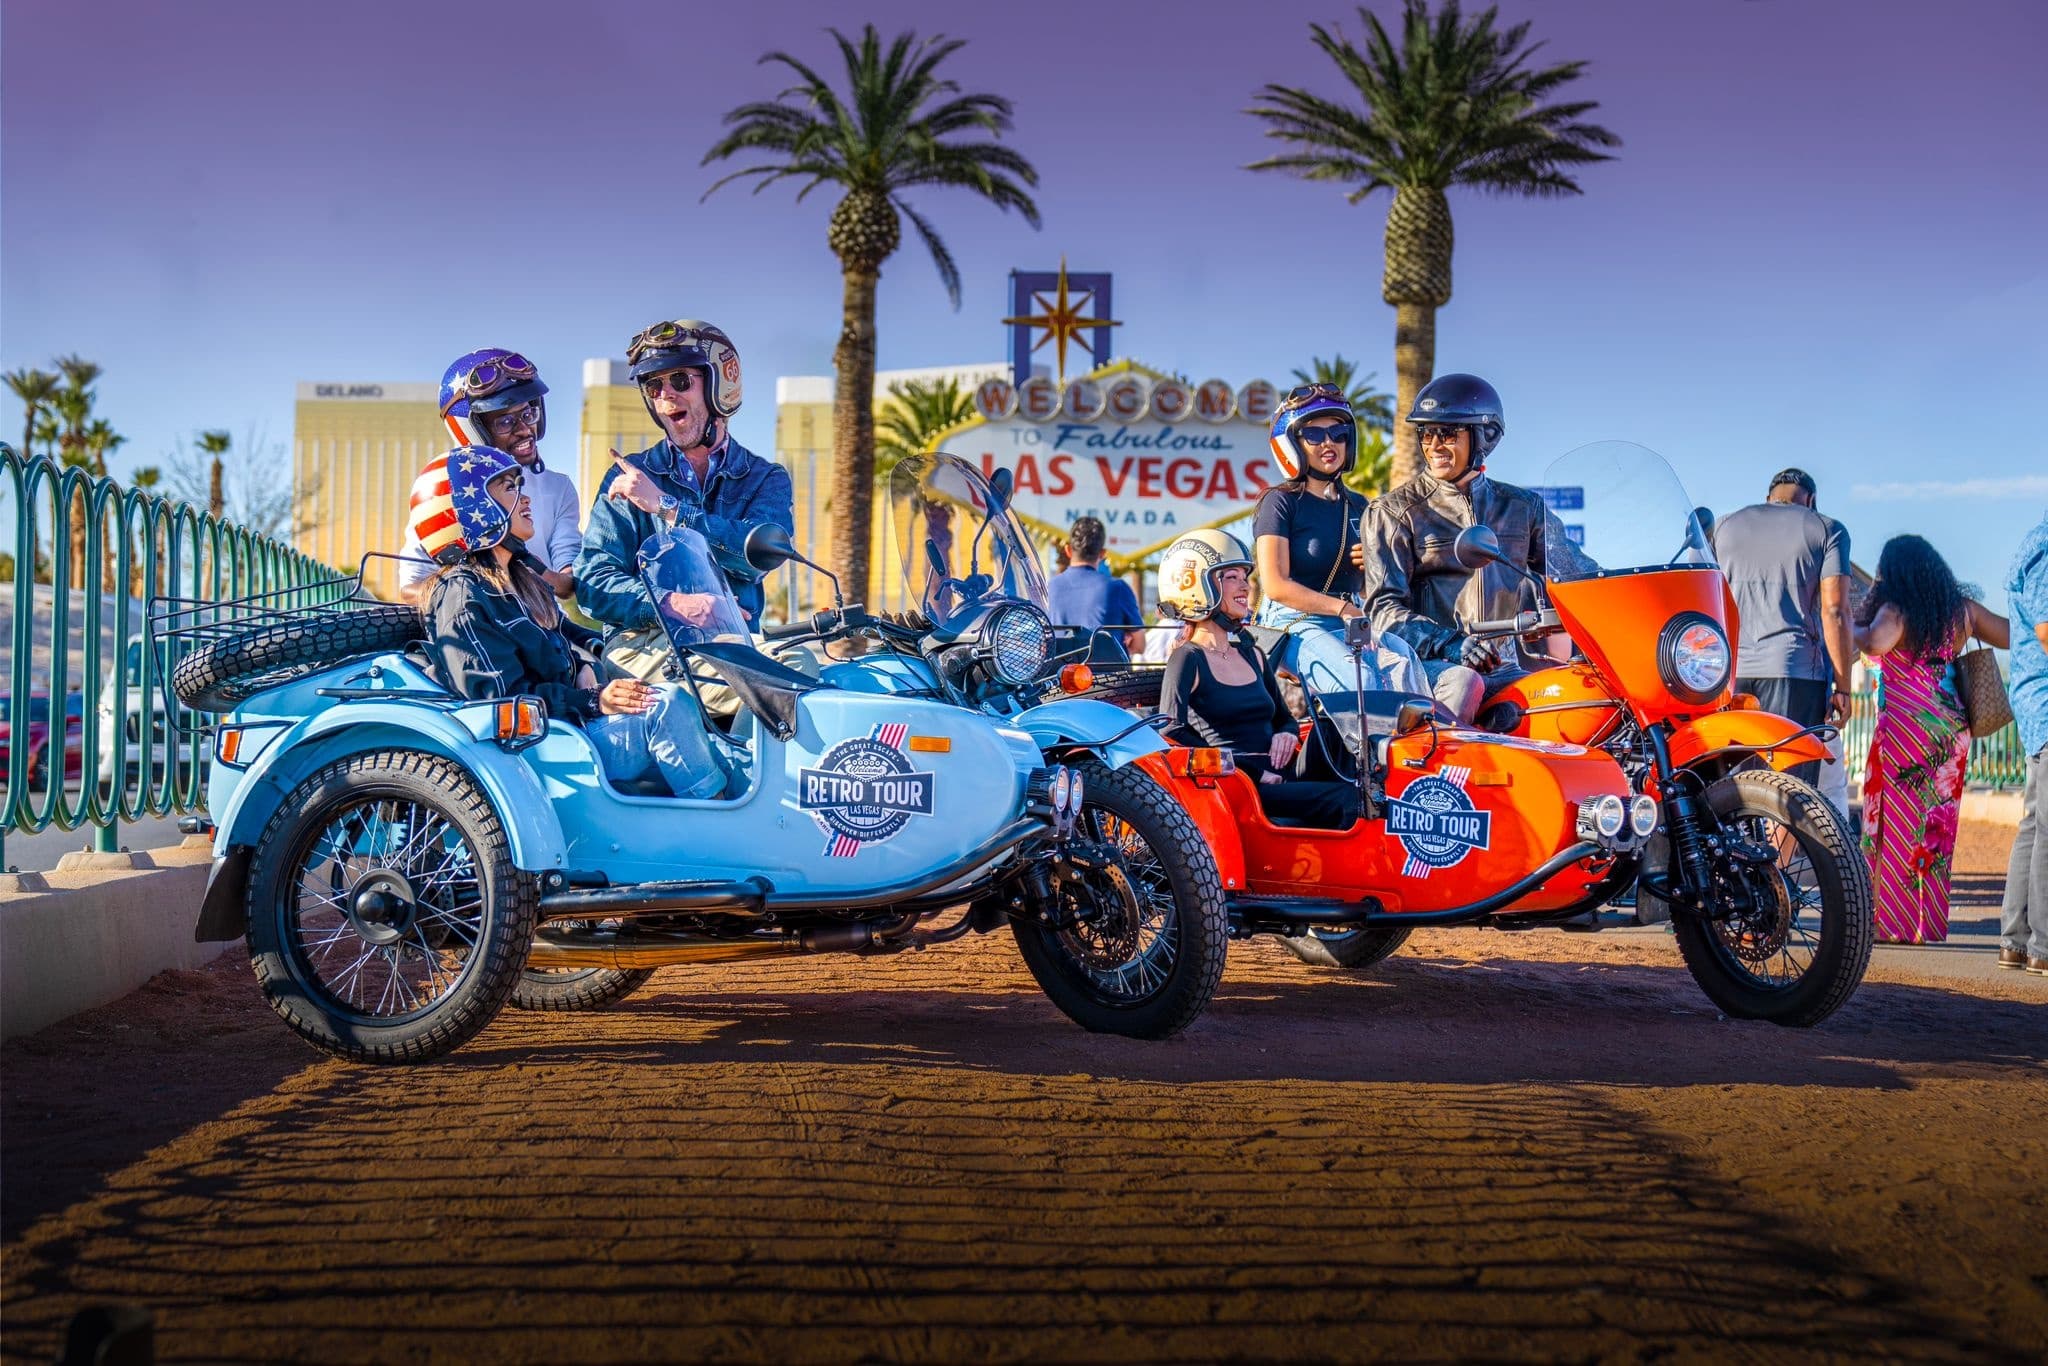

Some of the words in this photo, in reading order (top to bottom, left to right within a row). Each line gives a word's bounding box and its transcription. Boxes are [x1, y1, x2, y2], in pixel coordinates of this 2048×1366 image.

[726, 361, 739, 379] 66
[979, 381, 1270, 415] WELCOME
[1009, 427, 1042, 446] TO
[1053, 423, 1234, 450] Fabulous
[1095, 456, 1271, 501] VEGAS
[1194, 543, 1218, 566] CHICAGO
[836, 748, 849, 760] THE
[850, 743, 871, 751] GREAT
[873, 745, 897, 761] ESCAPE
[849, 765, 883, 774] Welcome
[806, 775, 864, 803] RETRO
[872, 781, 923, 807] TOUR
[850, 804, 862, 815] LAS
[862, 805, 880, 816] VEGAS
[829, 815, 858, 836] DISCOVER
[860, 817, 901, 838] DIFFERENTLY
[1391, 804, 1434, 832] RETRO
[1440, 815, 1481, 841] TOUR
[1423, 834, 1432, 842] LAS
[1432, 834, 1446, 844] VEGAS
